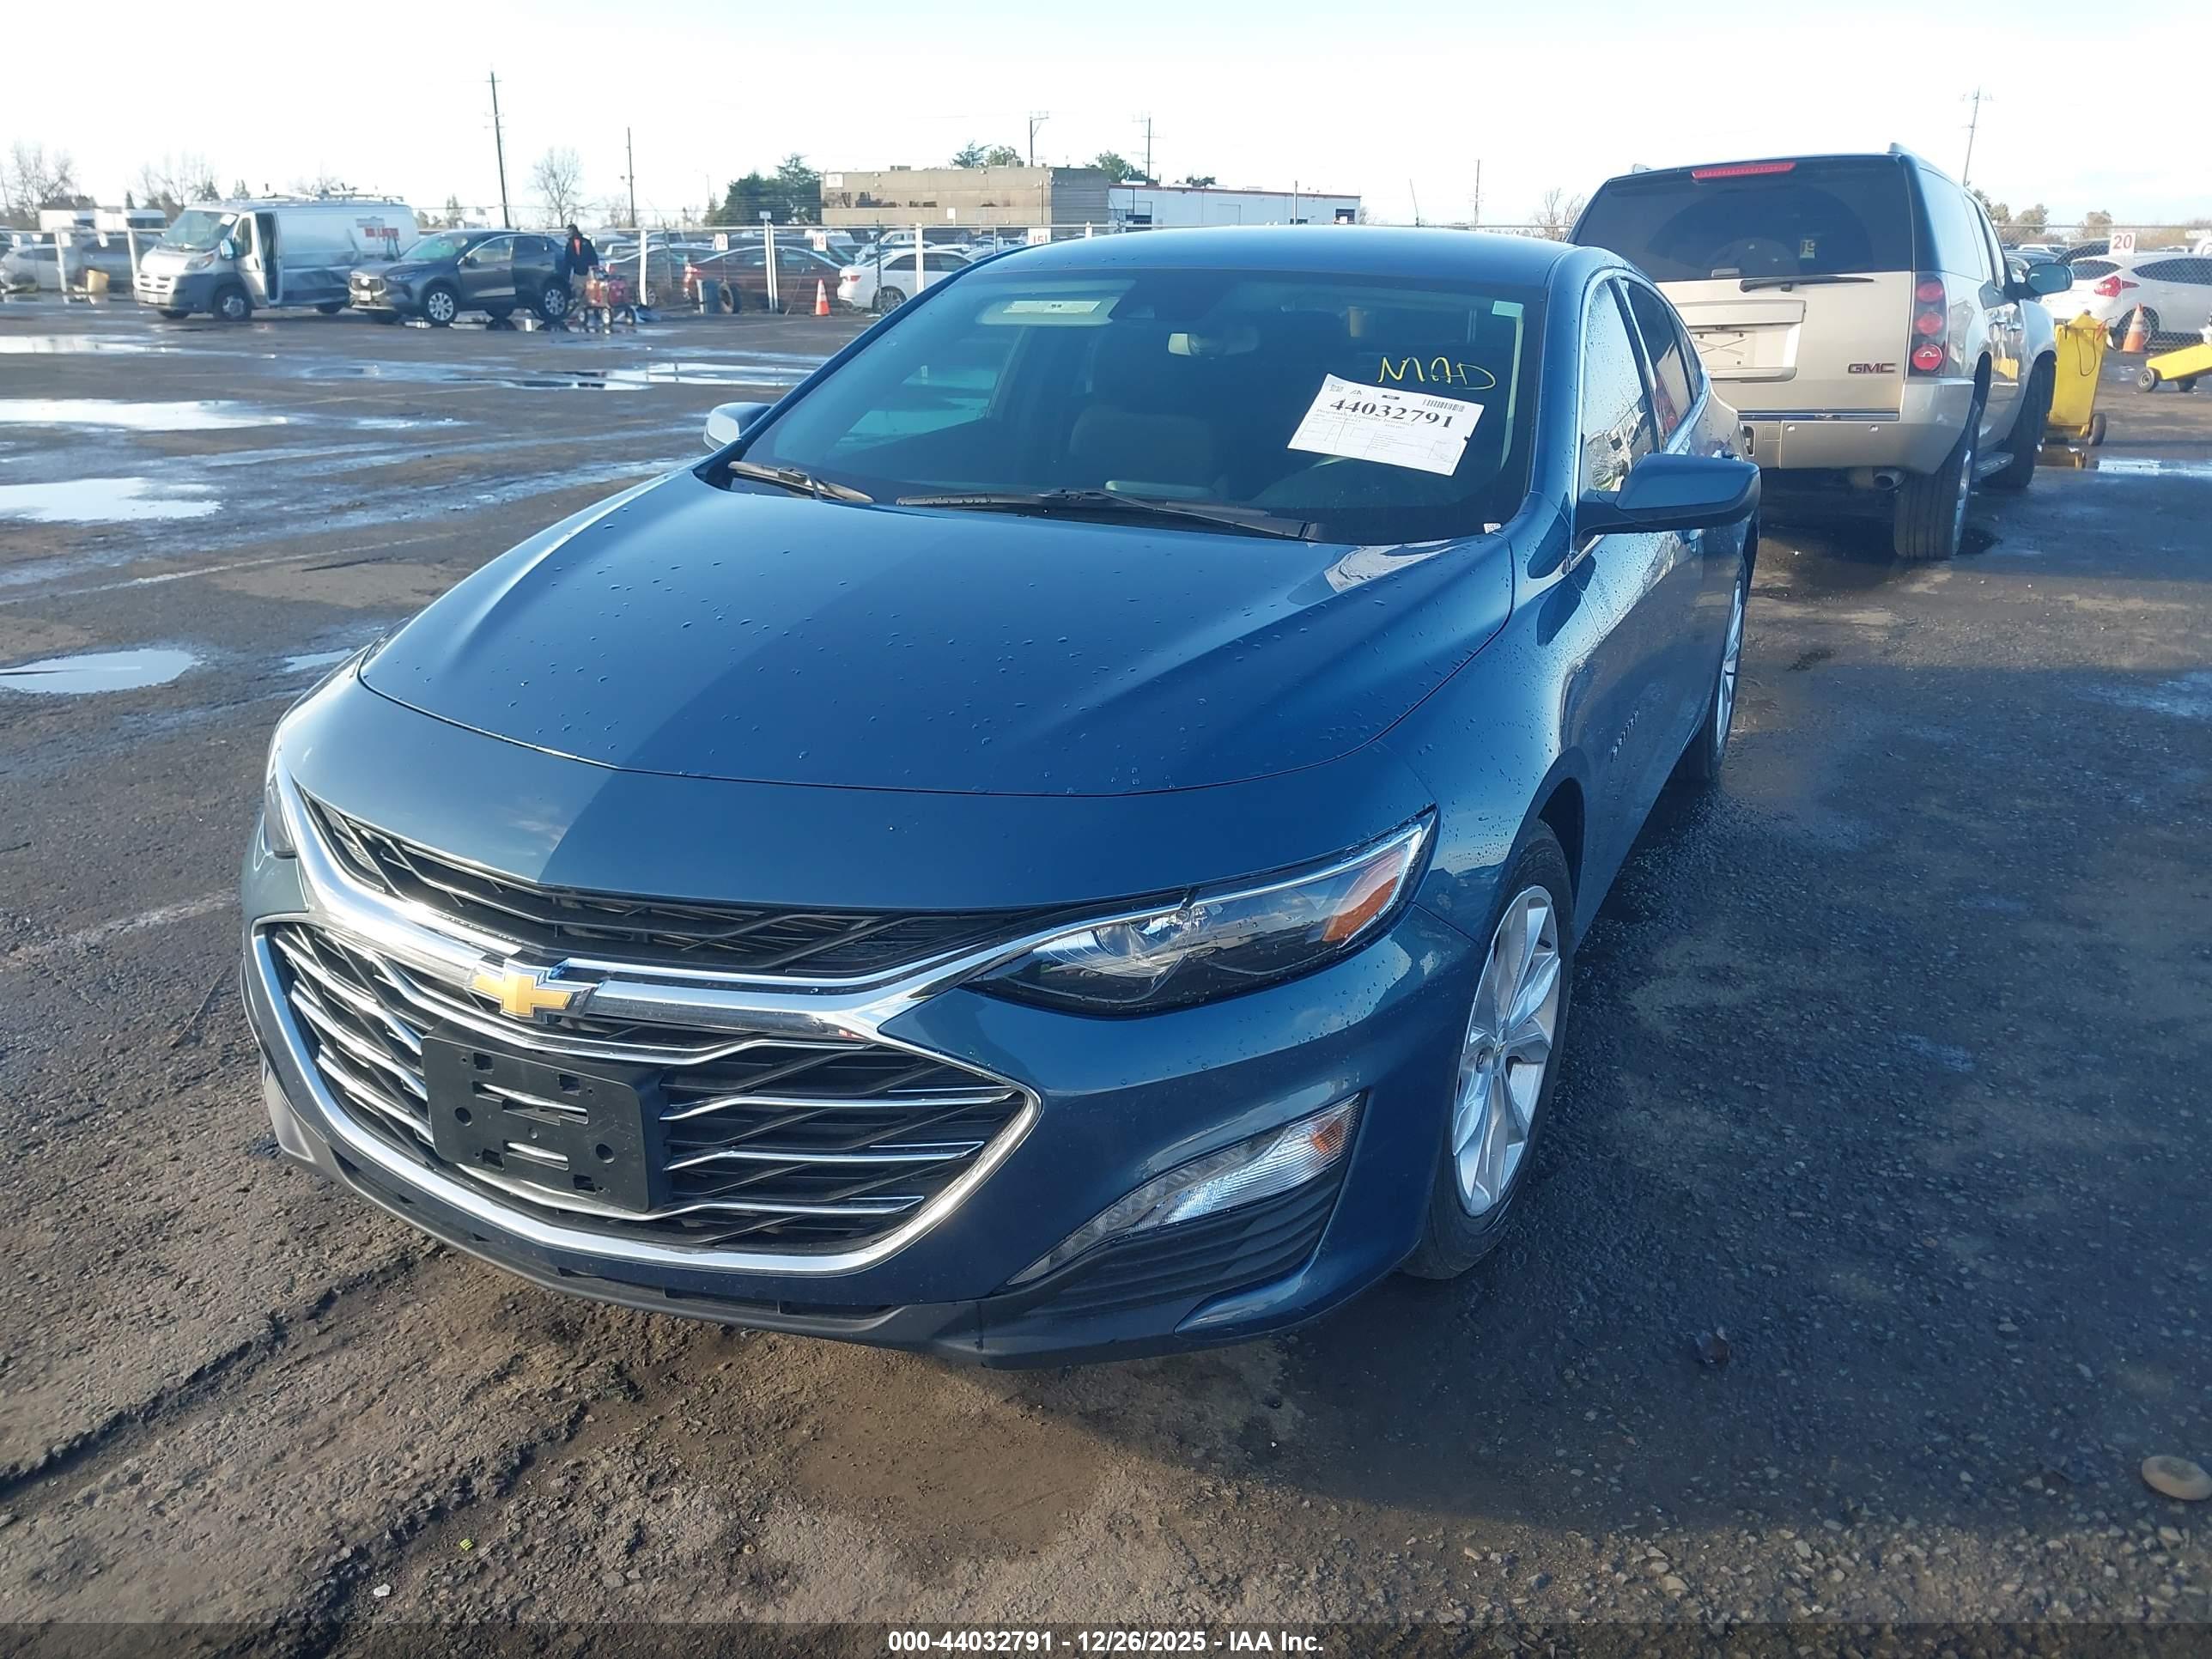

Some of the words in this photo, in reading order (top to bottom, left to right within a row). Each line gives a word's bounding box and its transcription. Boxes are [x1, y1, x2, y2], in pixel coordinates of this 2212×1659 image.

[2112, 234, 2133, 250] 20
[1848, 362, 1897, 374] GMC
[1329, 398, 1455, 428] 44032791
